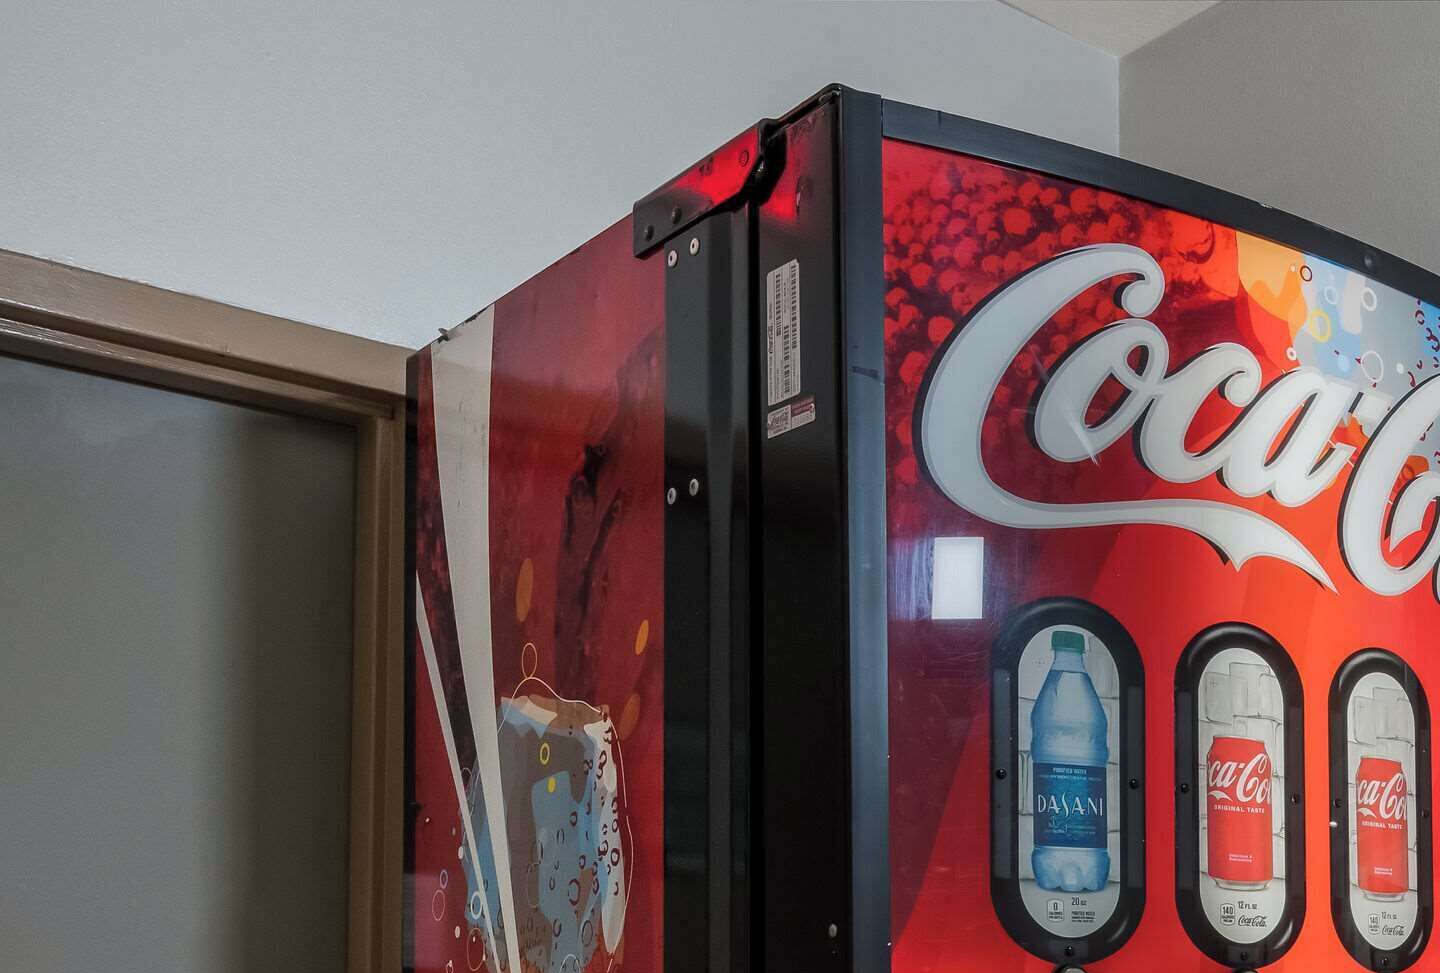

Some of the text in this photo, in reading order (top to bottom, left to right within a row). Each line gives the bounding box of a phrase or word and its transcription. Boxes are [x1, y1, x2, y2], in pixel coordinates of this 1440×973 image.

[1037, 792, 1103, 818] DASANI
[1247, 806, 1265, 814] TASTE
[1071, 896, 1080, 906] 20
[1237, 900, 1244, 910] 12
[1222, 905, 1234, 915] 140
